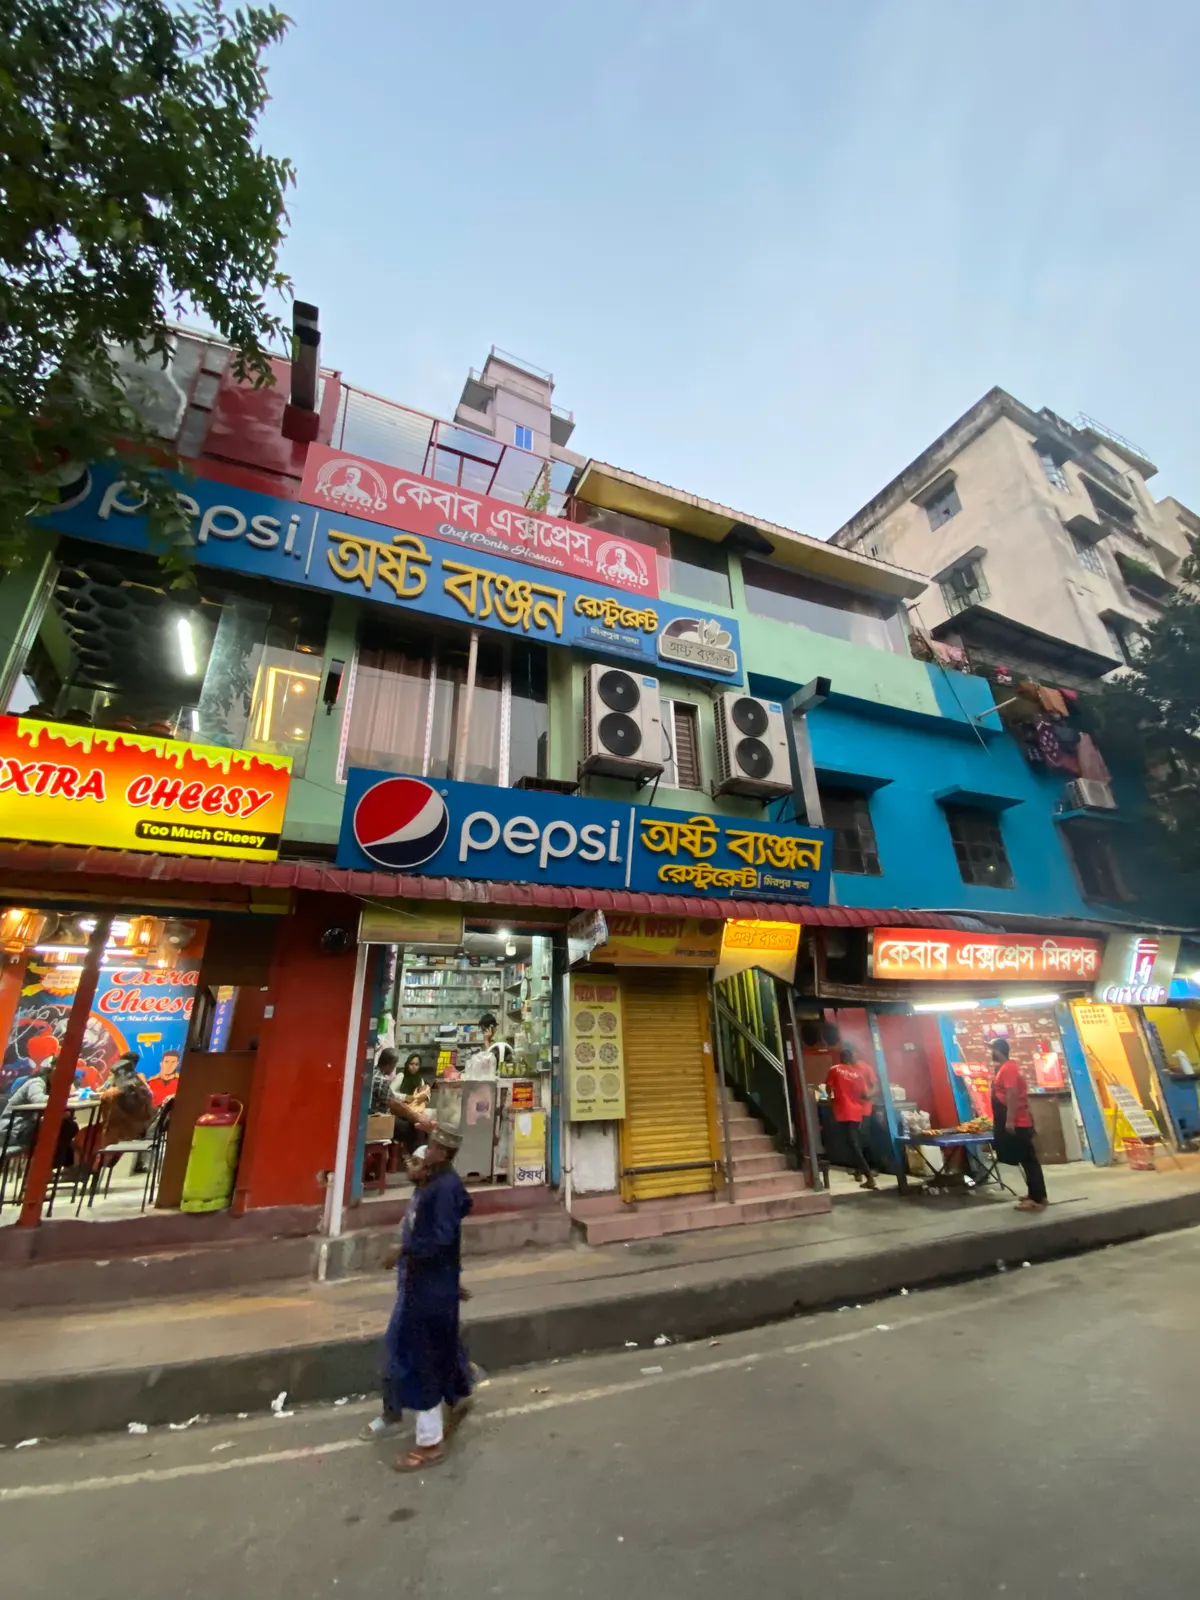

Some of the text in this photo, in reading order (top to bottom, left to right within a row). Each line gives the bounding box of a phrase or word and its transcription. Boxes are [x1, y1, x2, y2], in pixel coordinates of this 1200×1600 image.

[393, 478, 482, 528] কেবাব
[491, 508, 592, 559] এক্সপ্রেস
[327, 529, 432, 599] অষ্ট
[442, 559, 566, 636] ব্যঞ্জন
[141, 822, 266, 848] Too Much Cheesy
[458, 811, 621, 868] pepsi
[640, 815, 824, 871] অষ্ট ব্যঞ্জন
[877, 939, 1097, 976] কেবাব এক্সপ্রেস মিরপুর
[98, 988, 195, 1020] Cheesy
[126, 1014, 148, 1022] Much
